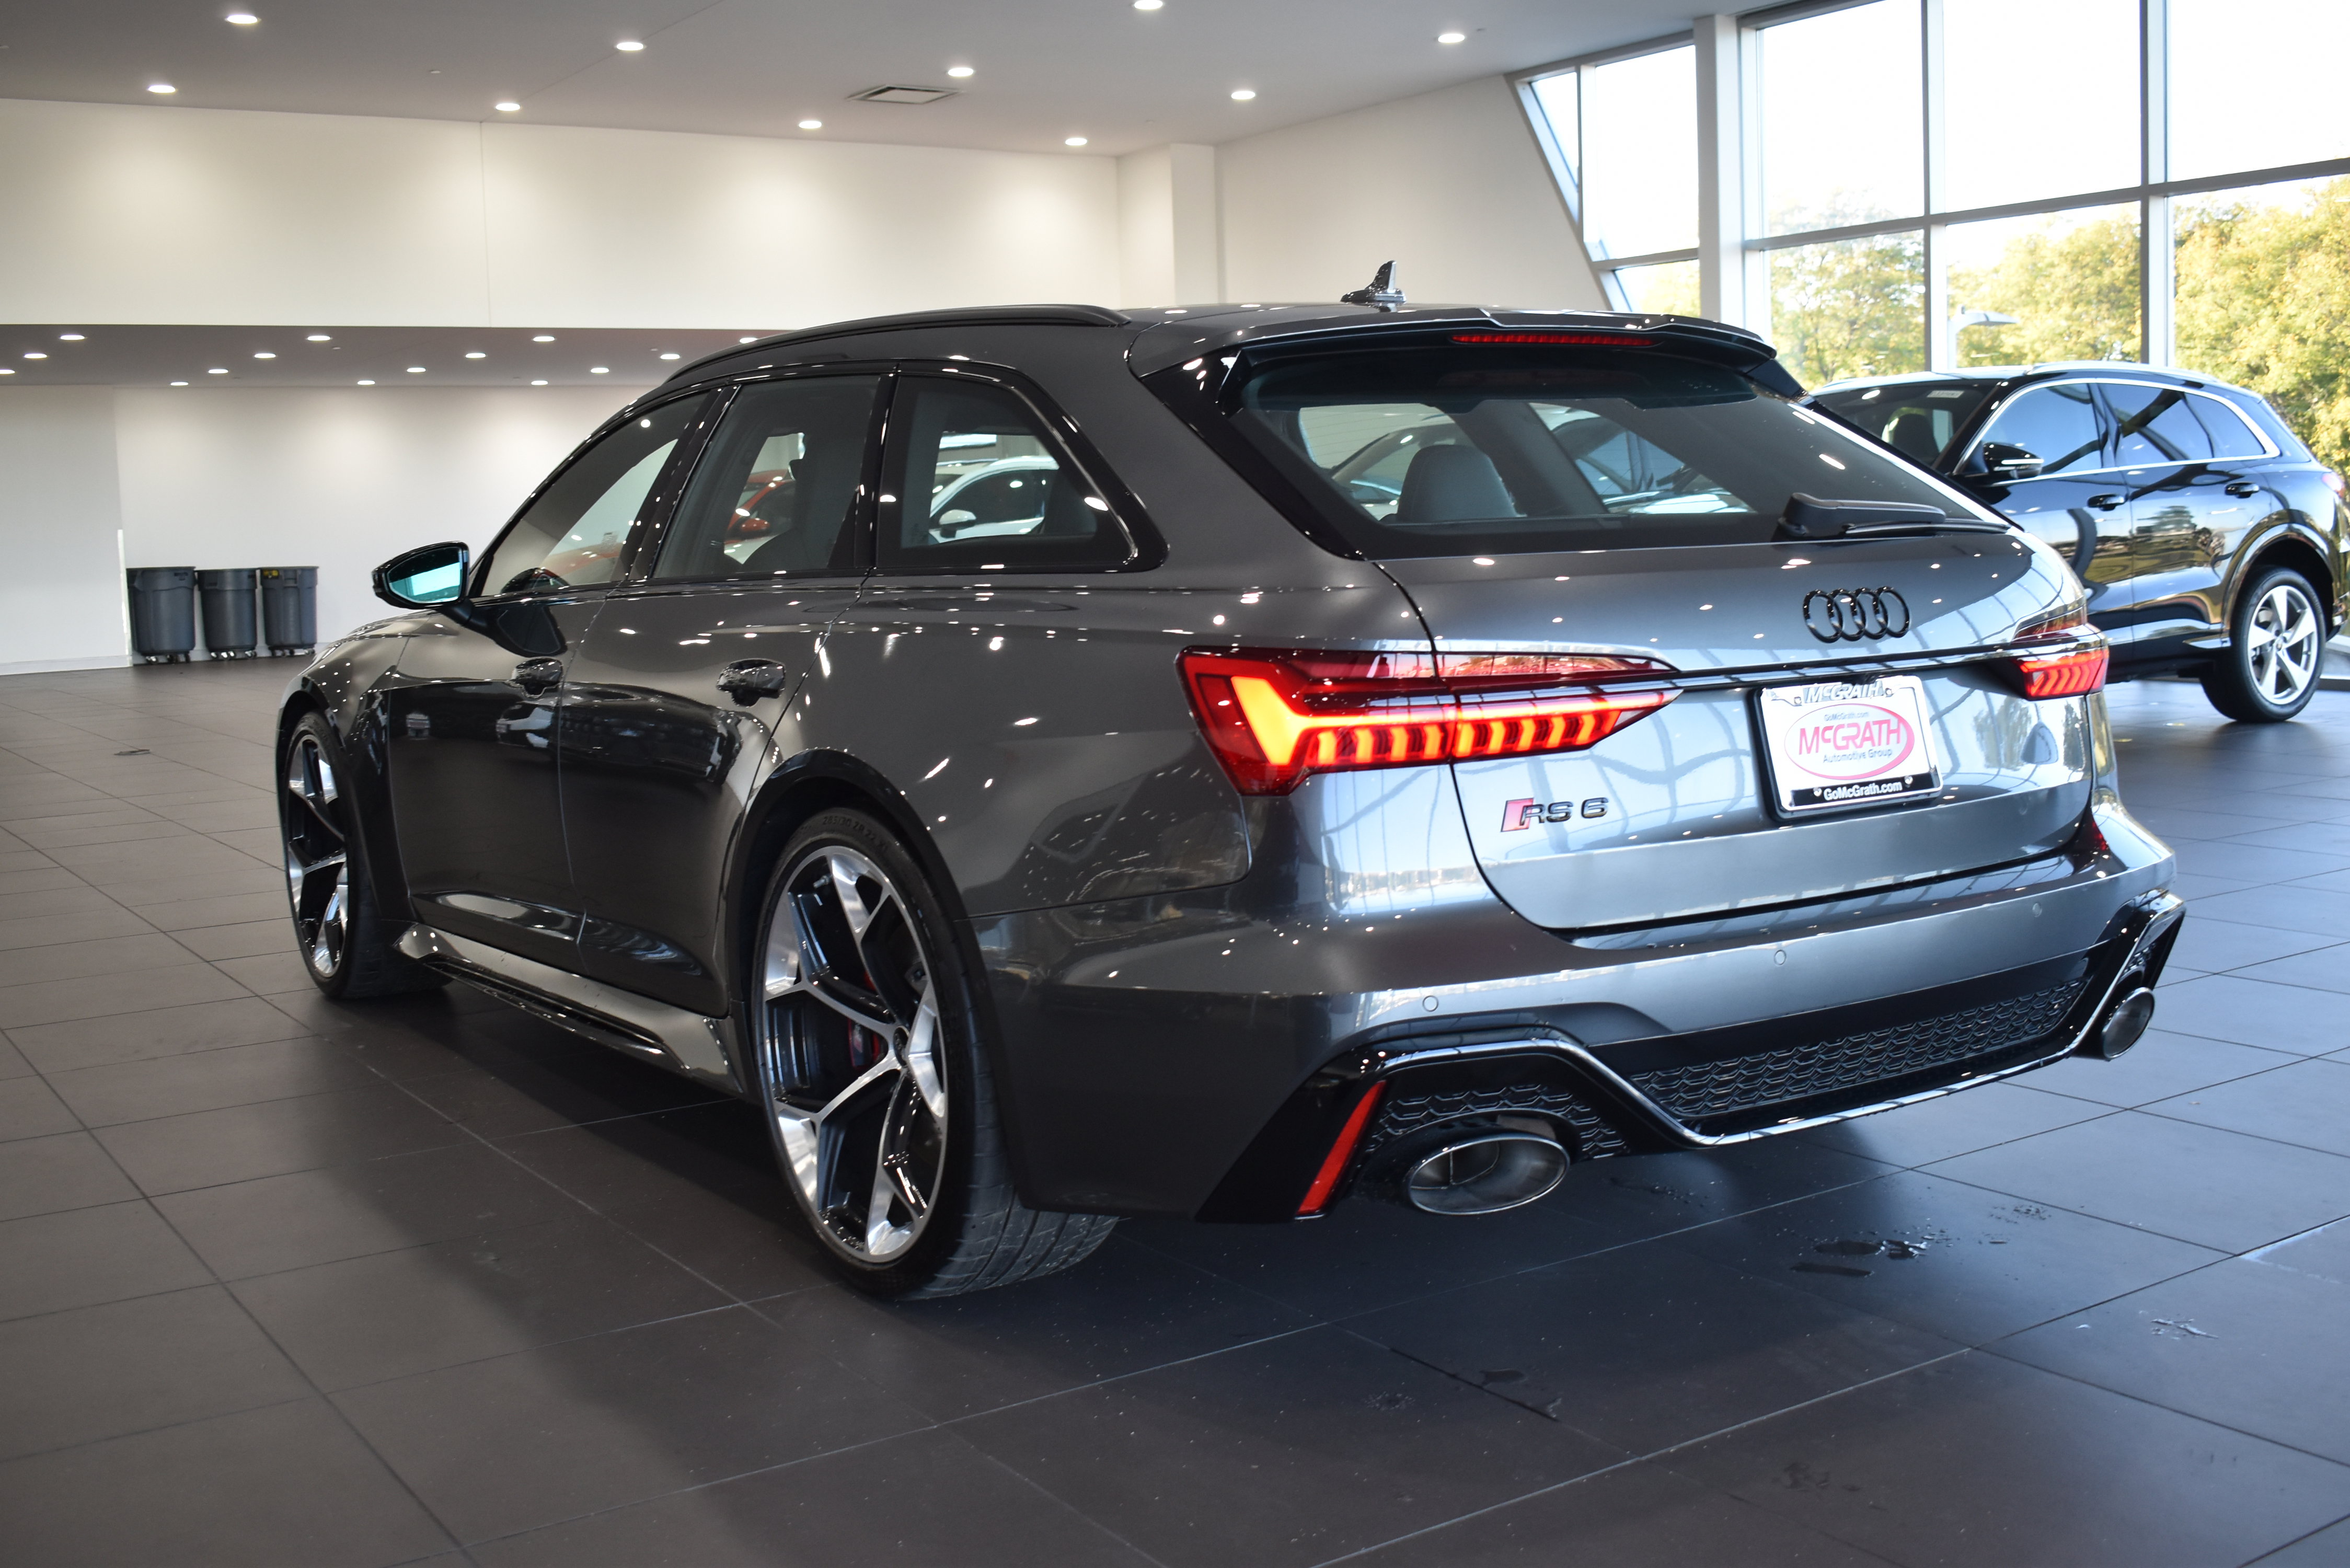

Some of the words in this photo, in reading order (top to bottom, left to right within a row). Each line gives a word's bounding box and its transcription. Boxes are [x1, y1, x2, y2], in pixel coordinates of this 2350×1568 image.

[1823, 751, 1866, 763] Automotive
[1868, 748, 1893, 759] Group
[1824, 781, 1903, 801] GoMcGrath.com
[1519, 801, 1574, 826] RS
[1581, 797, 1609, 819] 6
